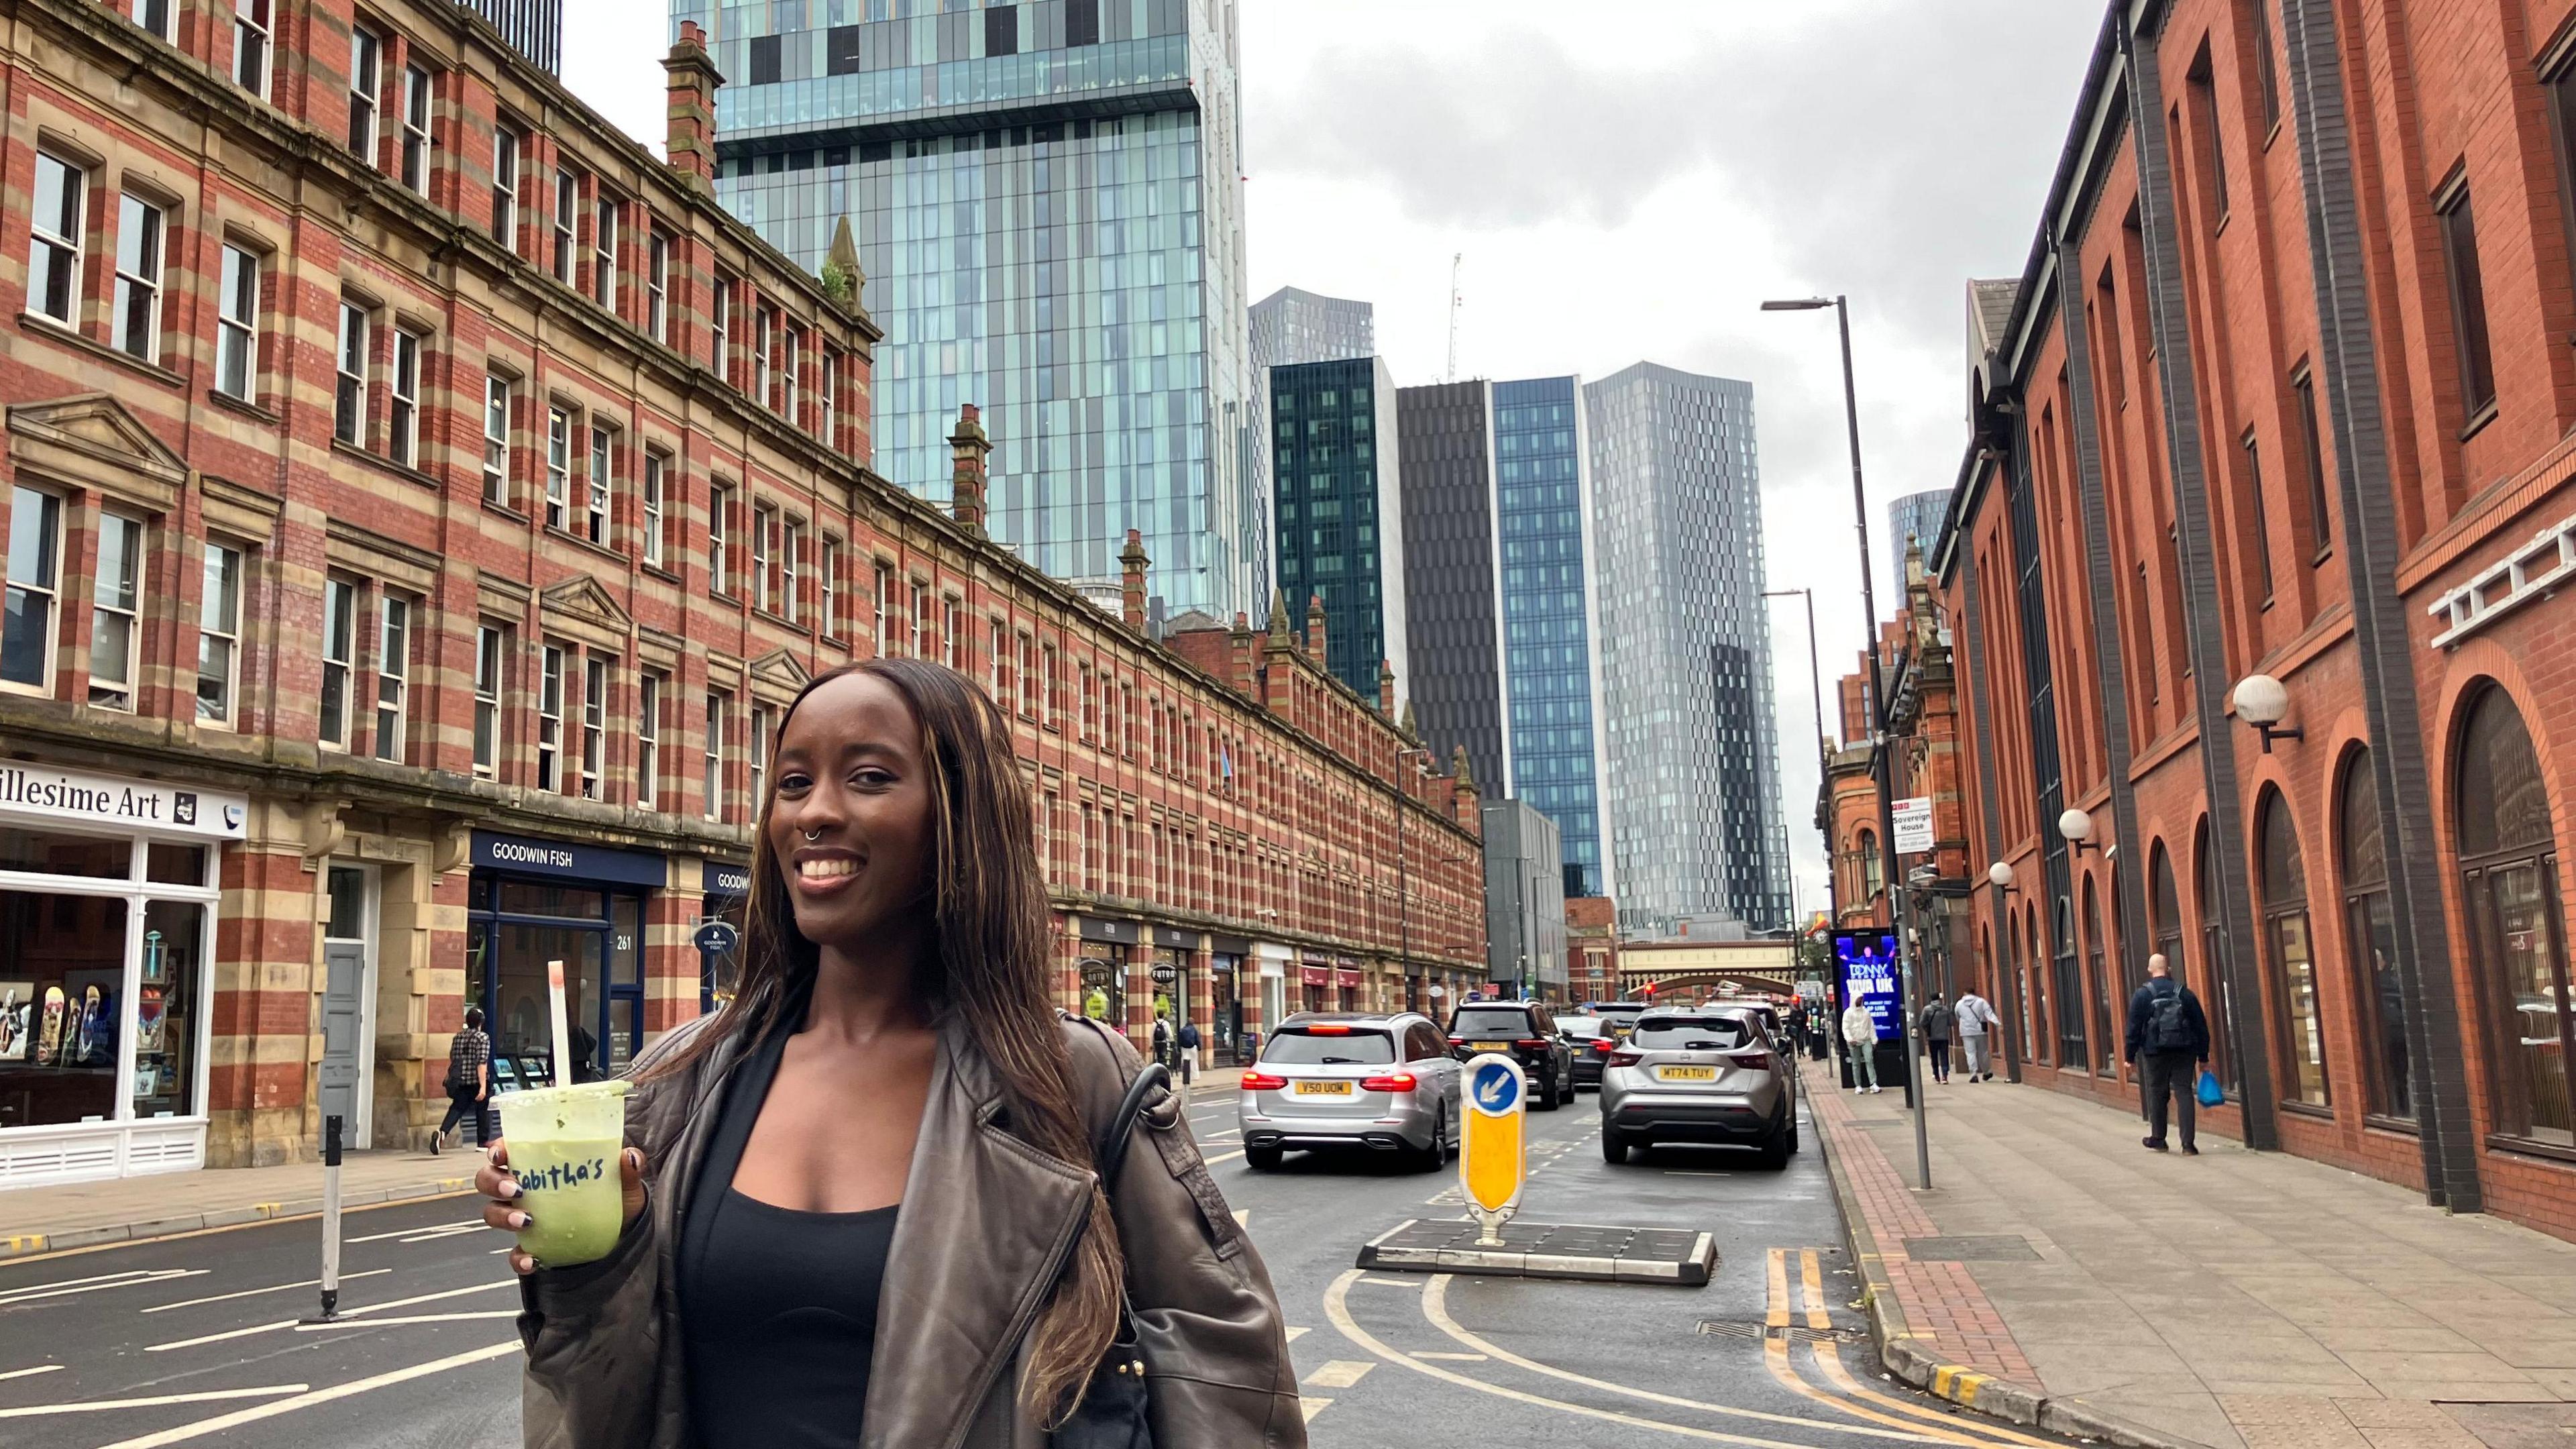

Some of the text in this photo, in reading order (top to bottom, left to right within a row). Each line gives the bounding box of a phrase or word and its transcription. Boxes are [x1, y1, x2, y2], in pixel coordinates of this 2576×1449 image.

[117, 787, 160, 819] Art
[1892, 813, 1931, 824] Sovereign
[492, 842, 572, 867] GOODWIN FISH
[617, 935, 631, 951] 261
[1876, 977, 1894, 993] UK
[1664, 1068, 1710, 1077] MT74 TUY
